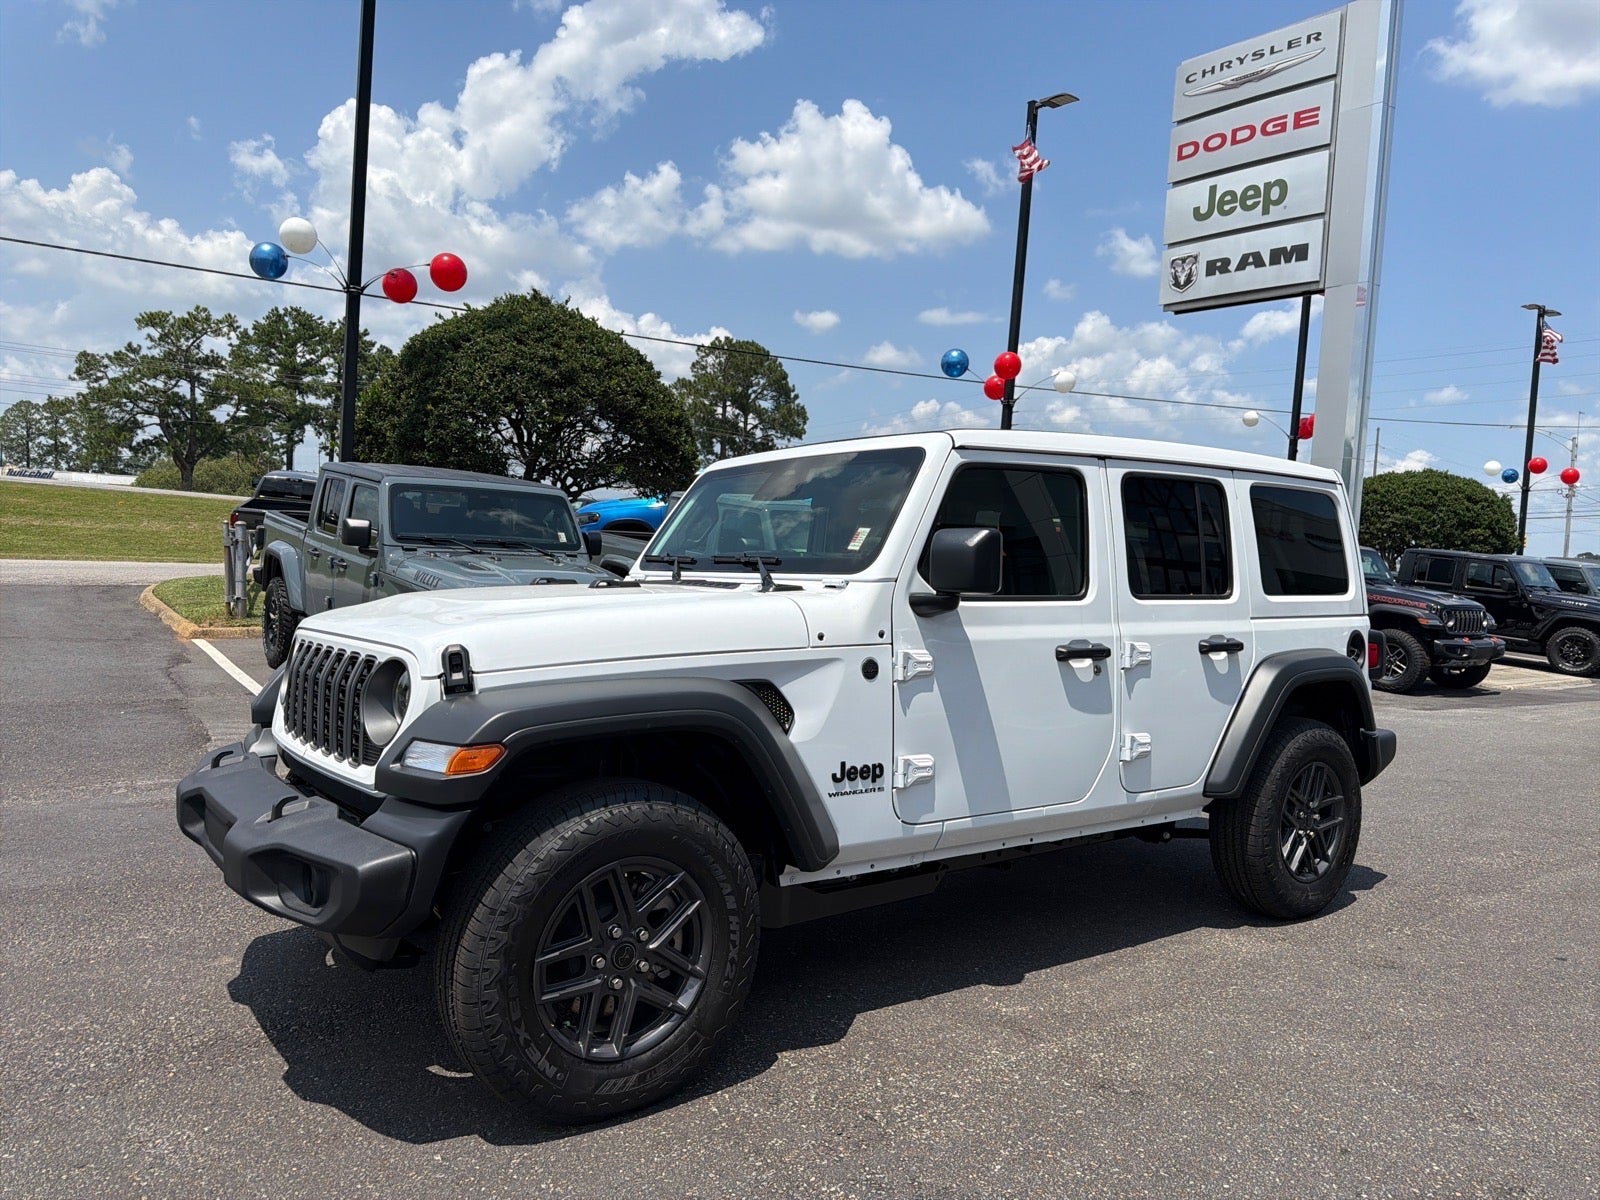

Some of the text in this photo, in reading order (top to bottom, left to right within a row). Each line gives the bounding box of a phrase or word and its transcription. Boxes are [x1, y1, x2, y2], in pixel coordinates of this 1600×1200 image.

[1185, 31, 1323, 84] CHRYSLER
[1176, 106, 1321, 162] DODGE
[1192, 178, 1288, 222] Jeep
[1205, 243, 1309, 277] RAM
[831, 761, 884, 783] Jeep
[828, 787, 876, 798] WRANGLER
